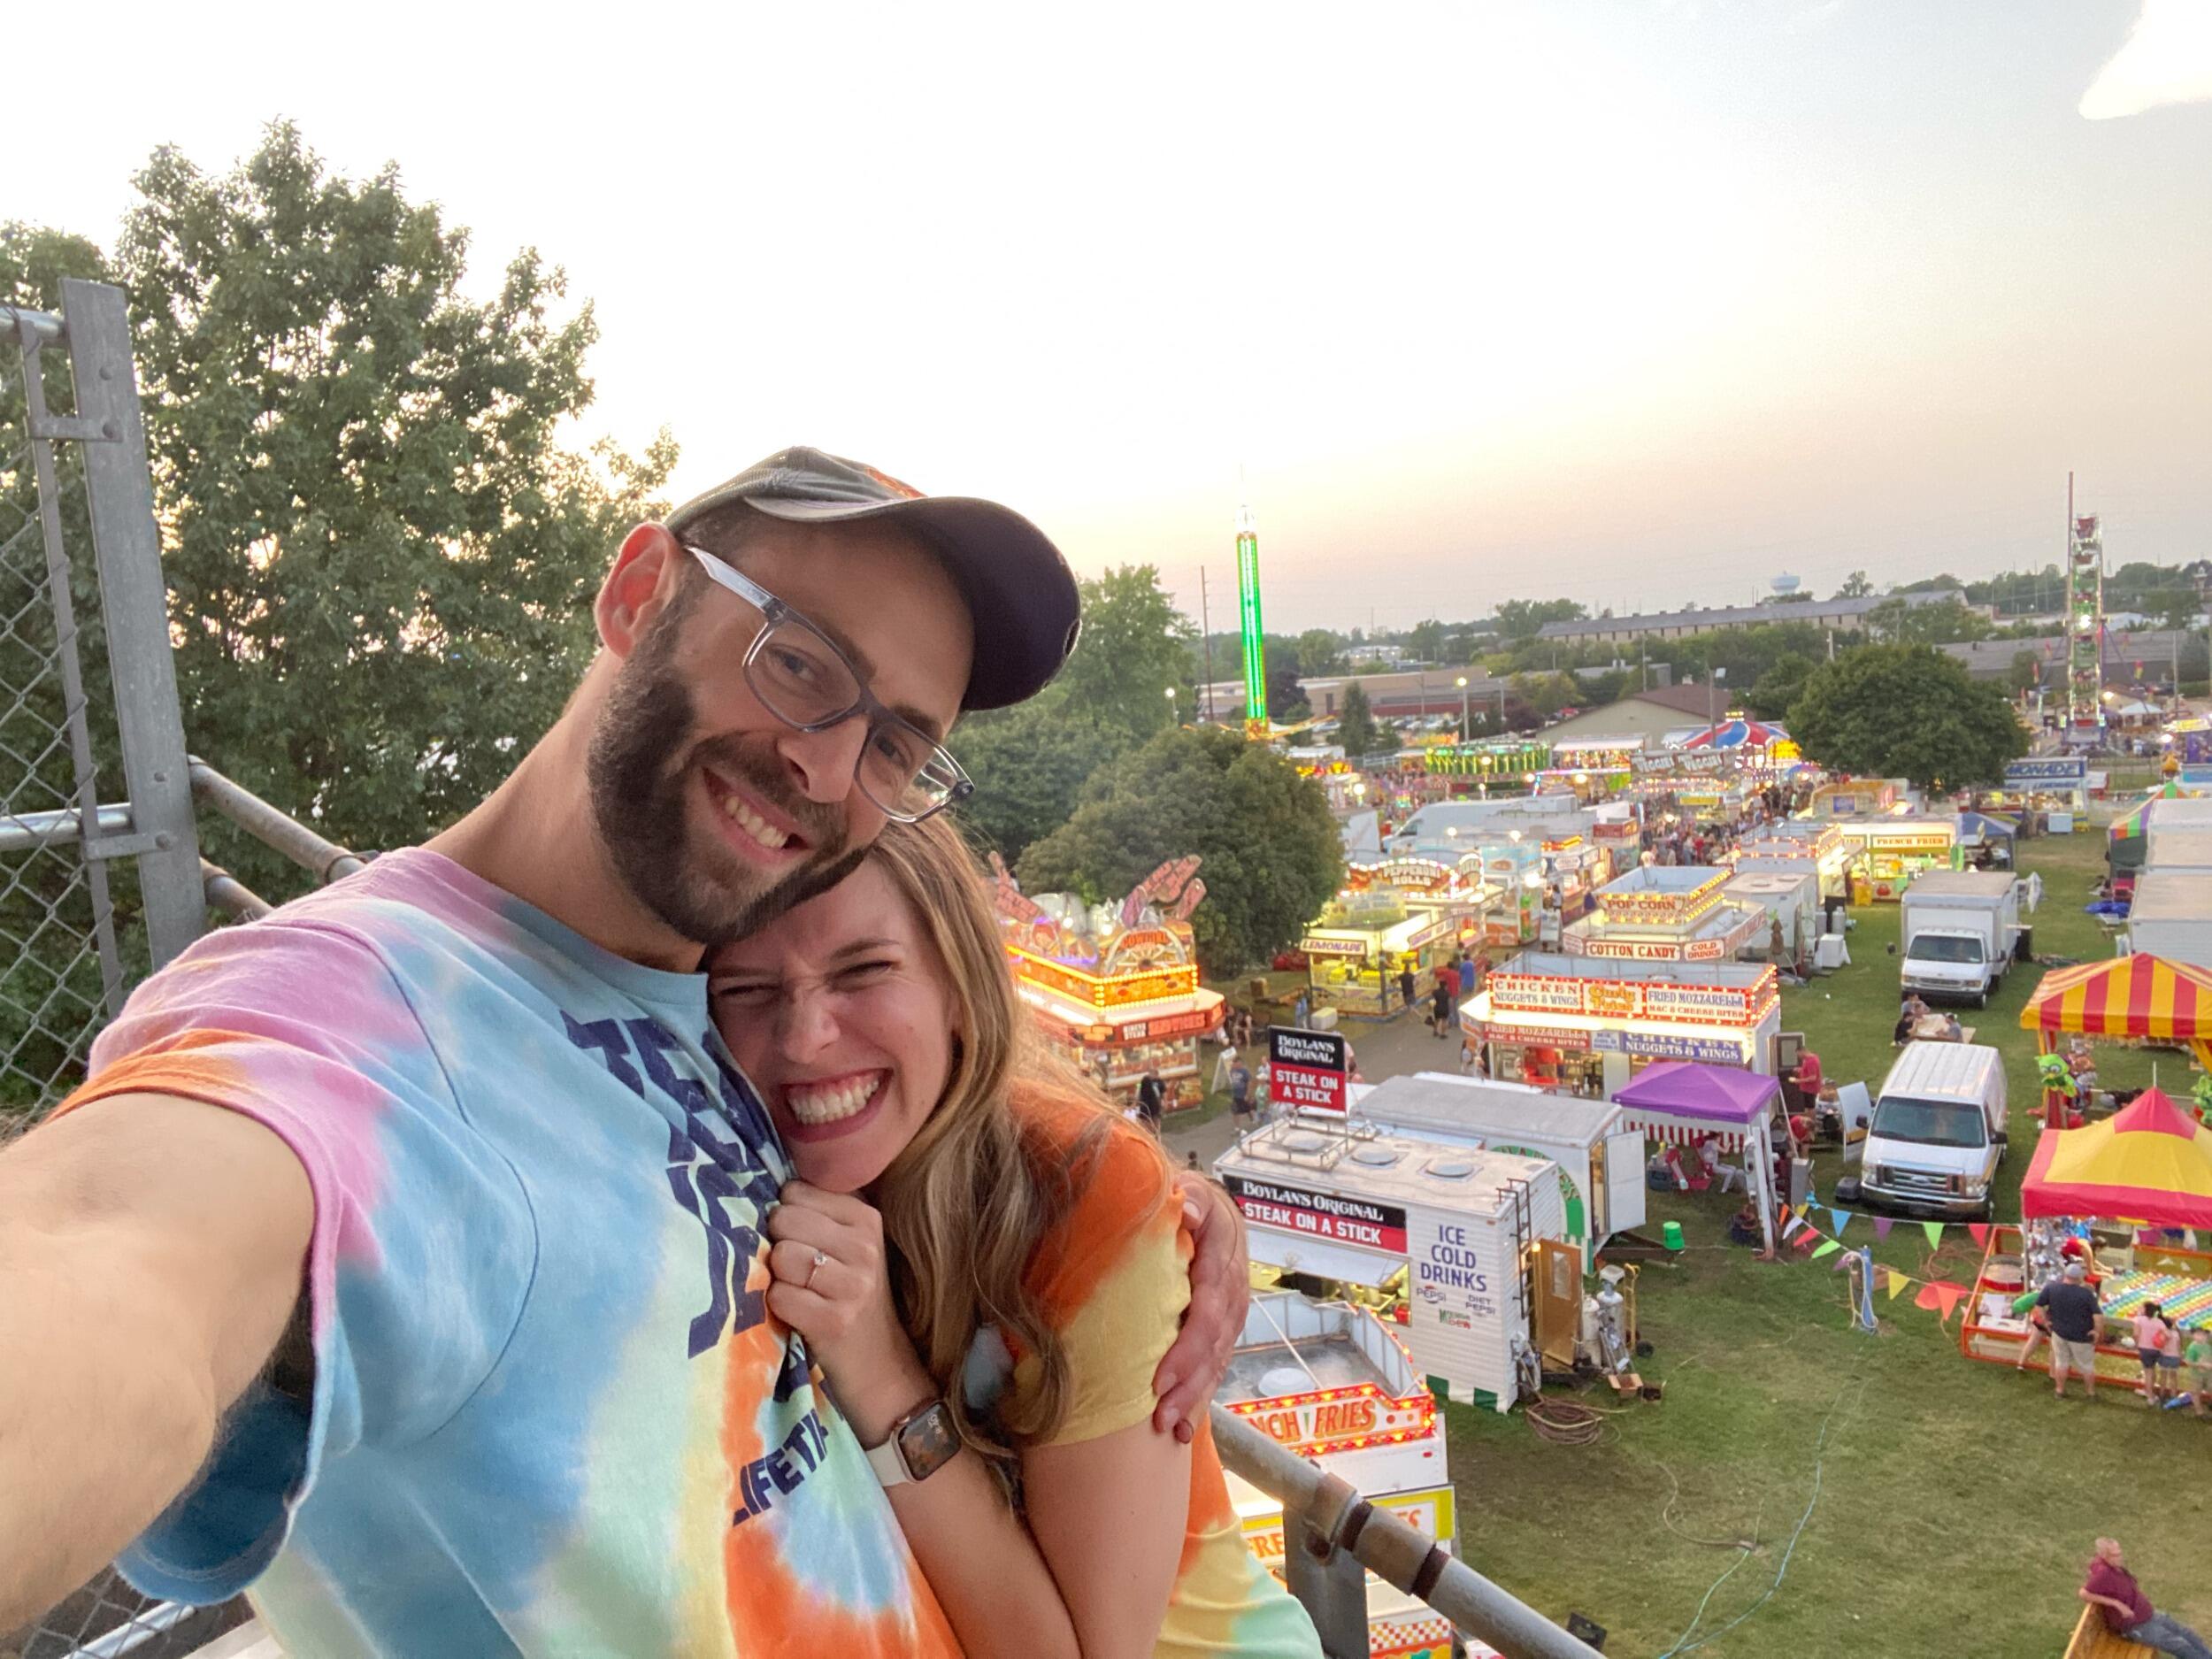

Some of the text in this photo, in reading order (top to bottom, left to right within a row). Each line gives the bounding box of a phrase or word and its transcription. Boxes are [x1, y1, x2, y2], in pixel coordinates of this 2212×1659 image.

[1607, 900, 1676, 910] POP CORN
[1302, 938, 1363, 952] LEMONADE
[1589, 943, 1633, 956] COTTON
[1638, 946, 1676, 958] CANDY
[1691, 941, 1717, 951] COLD
[1687, 949, 1721, 959] DRINKS
[1494, 979, 1578, 995] CHICKEN
[1494, 992, 1539, 1003] NUGGETS
[1550, 995, 1579, 1007] WINGS
[1648, 990, 1744, 1008] FRIED MOZZARELLA
[1678, 1007, 1715, 1016] CHEESE
[1717, 1009, 1745, 1018] BITES
[1485, 1023, 1516, 1034] FRIED
[1517, 1025, 1588, 1040] MOZZARELLA
[1517, 1034, 1555, 1045] CHEESE
[1557, 1037, 1586, 1047] BITES
[1278, 1045, 1334, 1064] ORIGINAL
[1625, 1041, 1683, 1056] NUGGETS
[1698, 1047, 1739, 1061] WINGS
[1276, 1069, 1339, 1090] STEAK ON
[1283, 1085, 1292, 1098] A
[1295, 1087, 1333, 1104] STICK
[1313, 1194, 1384, 1222] ORIGINAL
[1244, 1202, 1381, 1245] STEAK ON A STICK
[1439, 1224, 1466, 1247] ICE
[1431, 1244, 1477, 1270] COLD
[1420, 1262, 1487, 1293] DRINKS
[1468, 1294, 1493, 1306] DIET
[1314, 1399, 1376, 1439] FRIES
